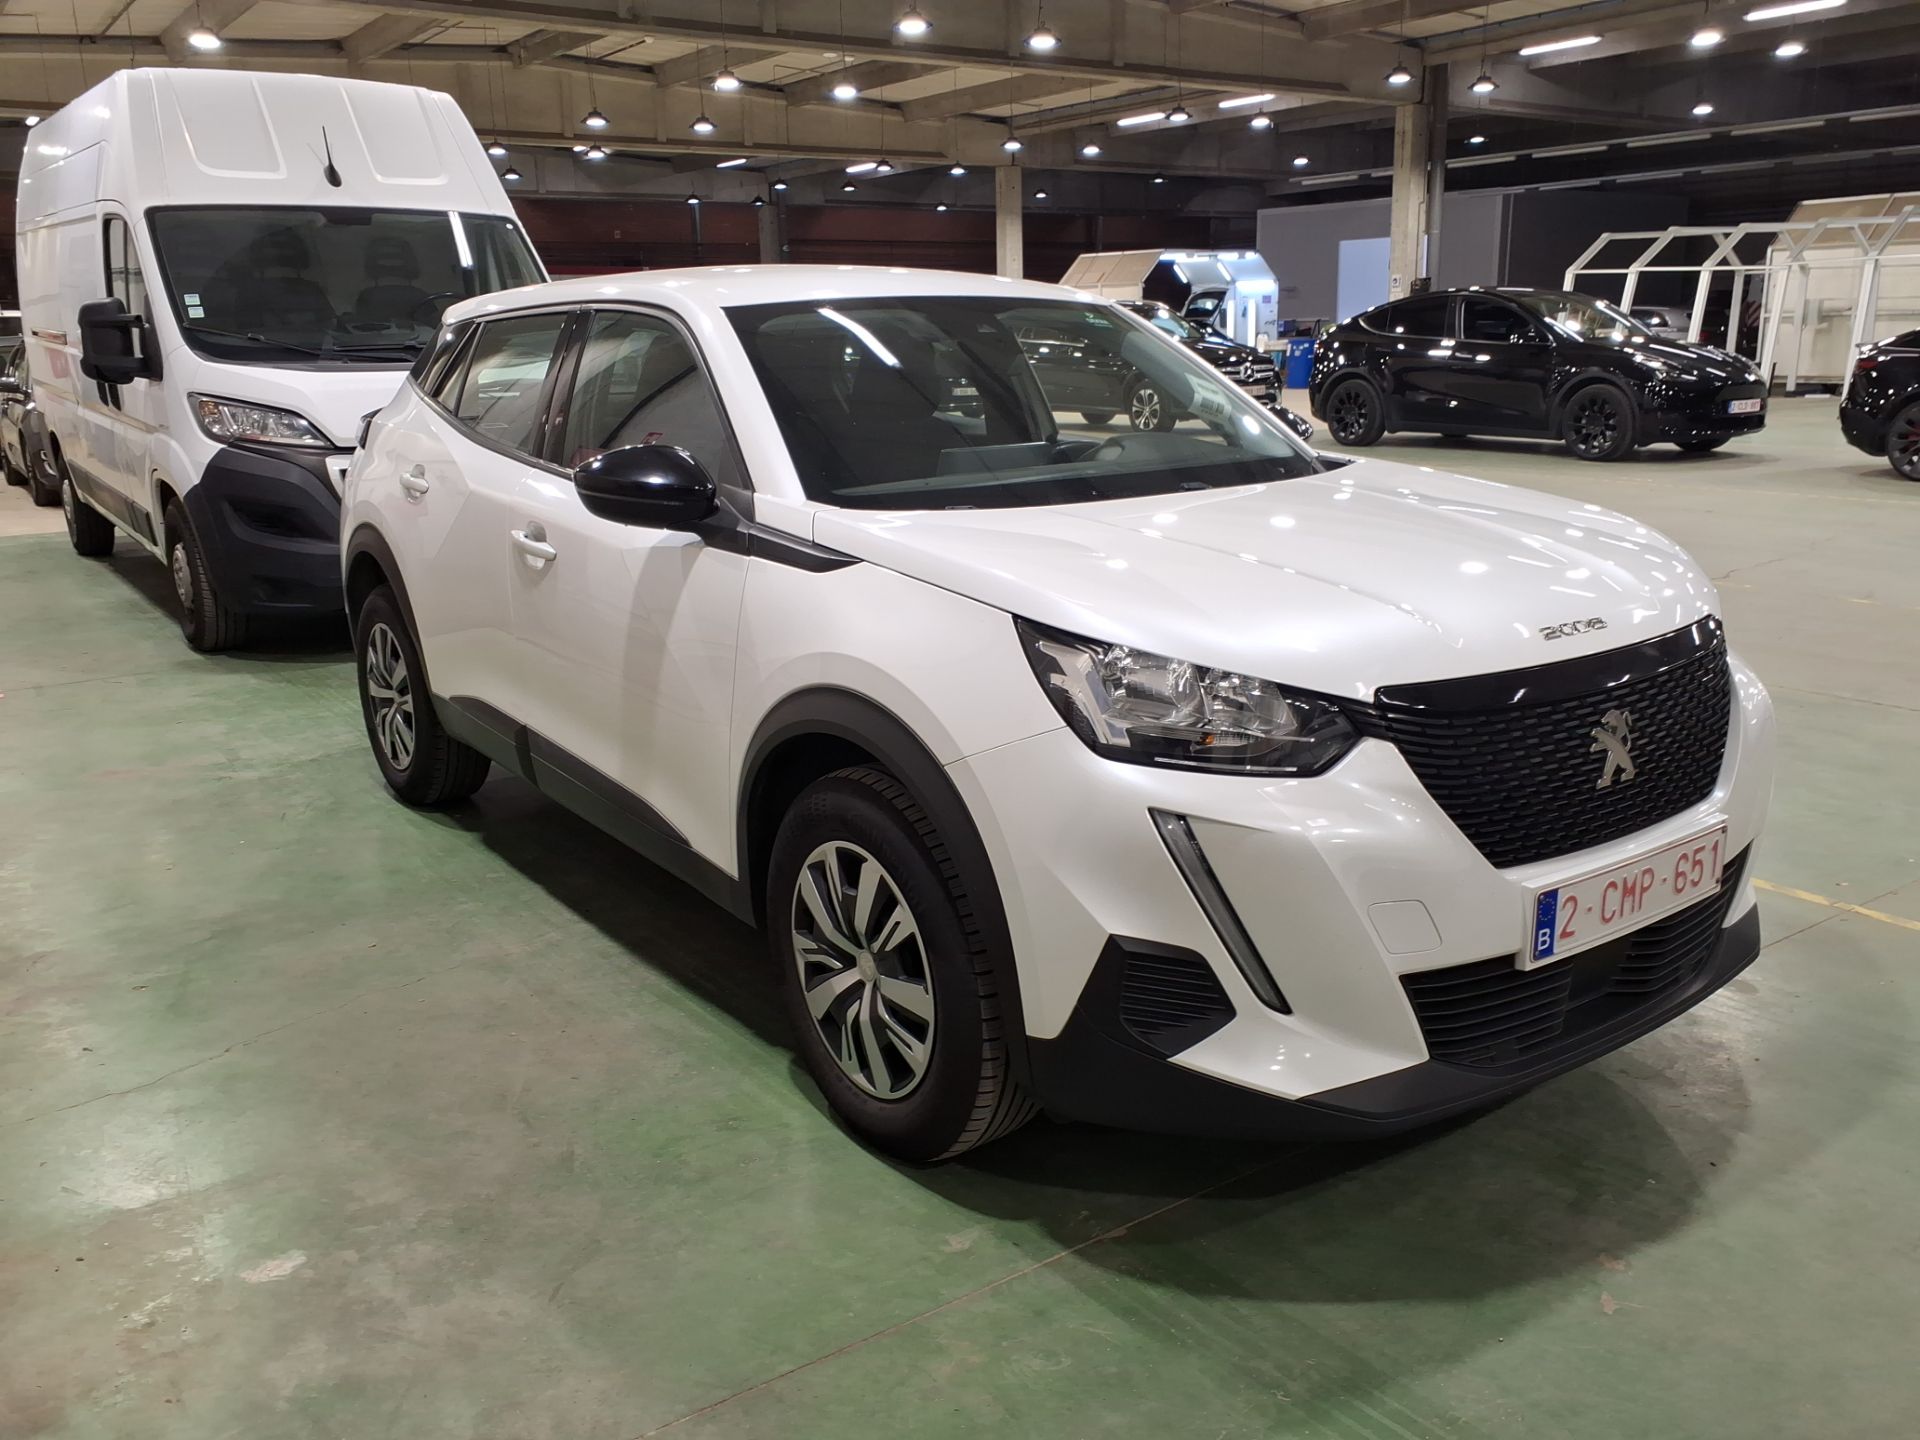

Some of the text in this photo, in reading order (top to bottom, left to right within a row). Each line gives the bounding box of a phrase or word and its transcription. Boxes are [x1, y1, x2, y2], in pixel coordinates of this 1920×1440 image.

[1539, 617, 1608, 641] 2008
[1558, 838, 1719, 940] 2-CMP-651
[1537, 928, 1551, 950] B
